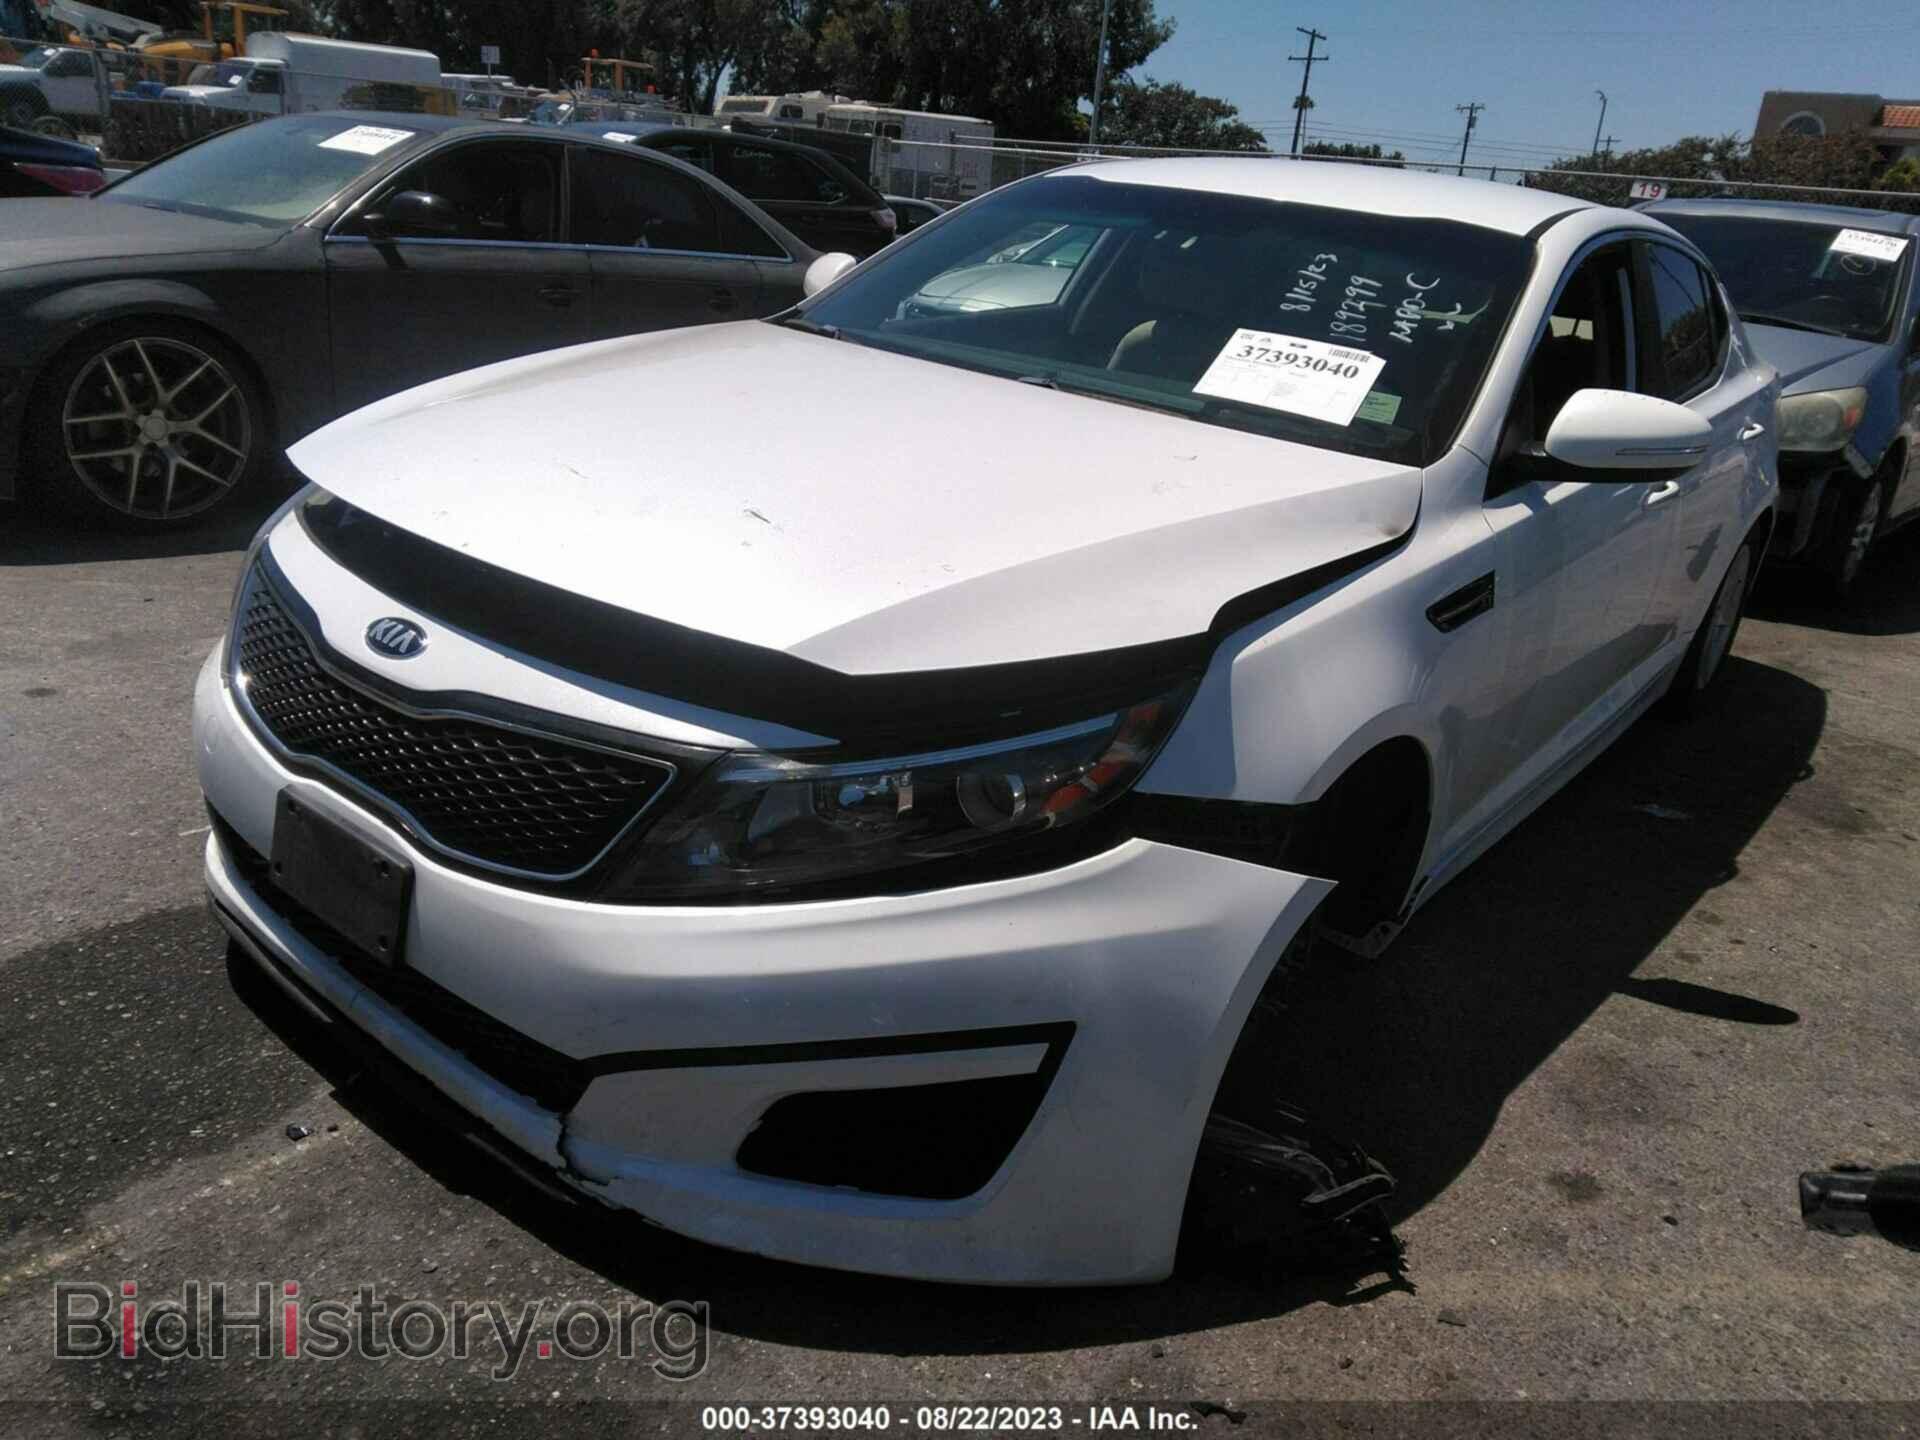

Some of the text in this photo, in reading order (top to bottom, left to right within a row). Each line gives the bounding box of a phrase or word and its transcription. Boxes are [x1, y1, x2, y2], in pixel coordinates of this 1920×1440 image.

[1640, 183, 1661, 197] 19
[1236, 345, 1359, 379] 37393040
[369, 619, 416, 653] KIA
